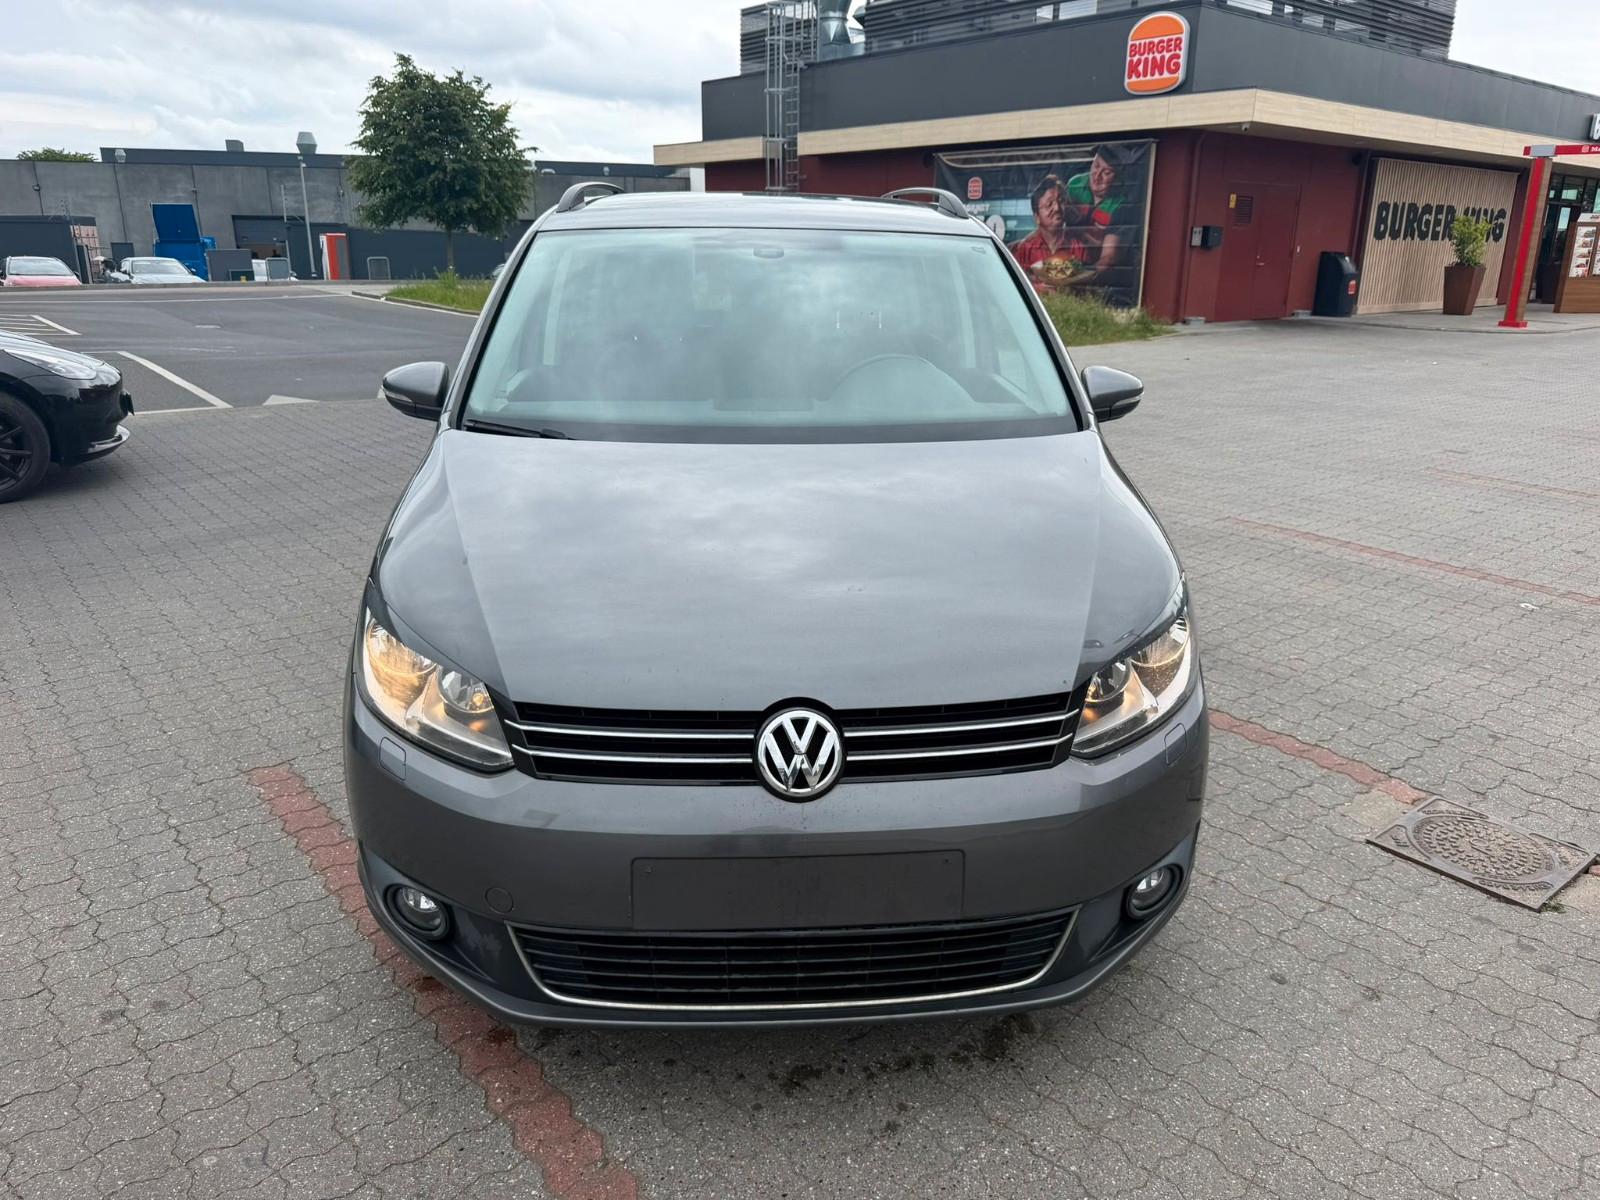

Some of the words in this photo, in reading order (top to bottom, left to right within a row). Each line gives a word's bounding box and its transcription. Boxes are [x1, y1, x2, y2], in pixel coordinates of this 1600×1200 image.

[1129, 36, 1183, 58] BURGER
[1127, 53, 1181, 80] KING
[1374, 201, 1456, 241] BURGER
